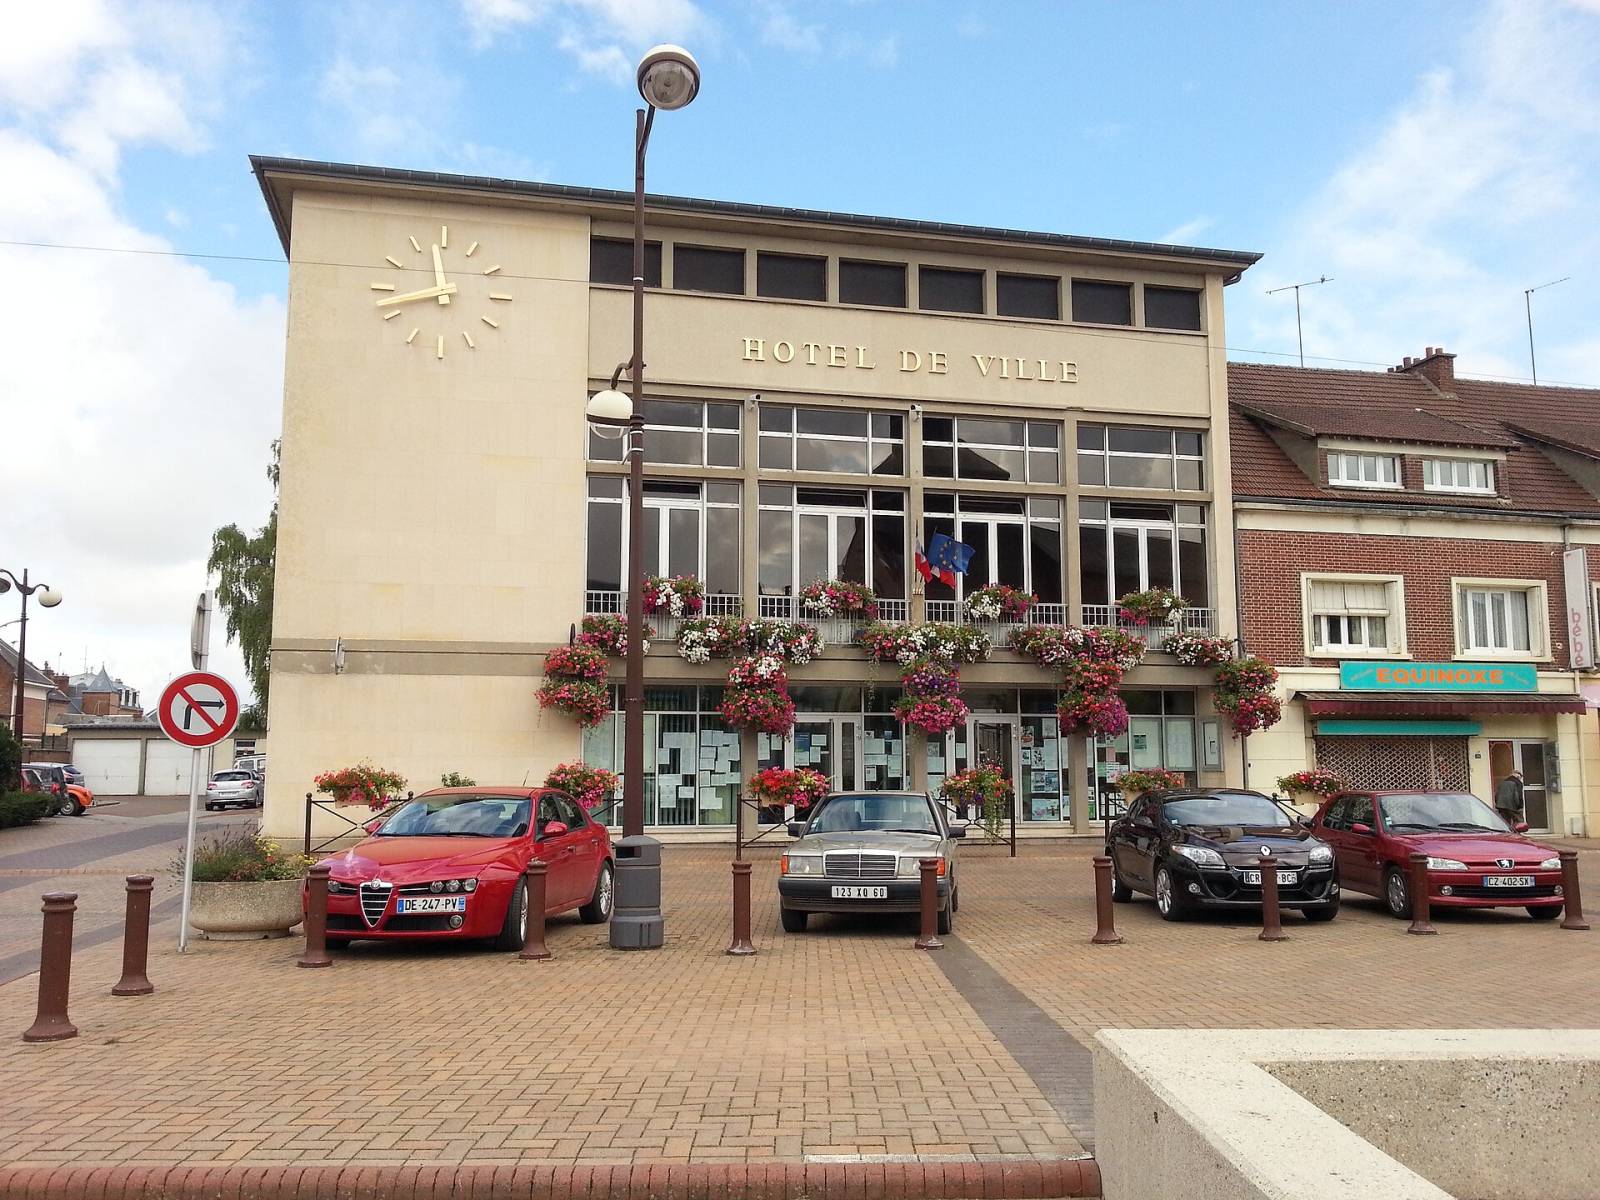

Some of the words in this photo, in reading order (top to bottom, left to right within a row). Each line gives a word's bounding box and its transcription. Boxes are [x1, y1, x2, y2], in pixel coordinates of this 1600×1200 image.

[742, 337, 877, 369] HOTEL
[899, 350, 949, 374] DE
[972, 354, 1079, 383] VILLE
[1375, 667, 1504, 685] EQUINOXE
[836, 887, 852, 897] 123
[873, 887, 885, 898] 60
[404, 897, 458, 911] DE-247-PV
